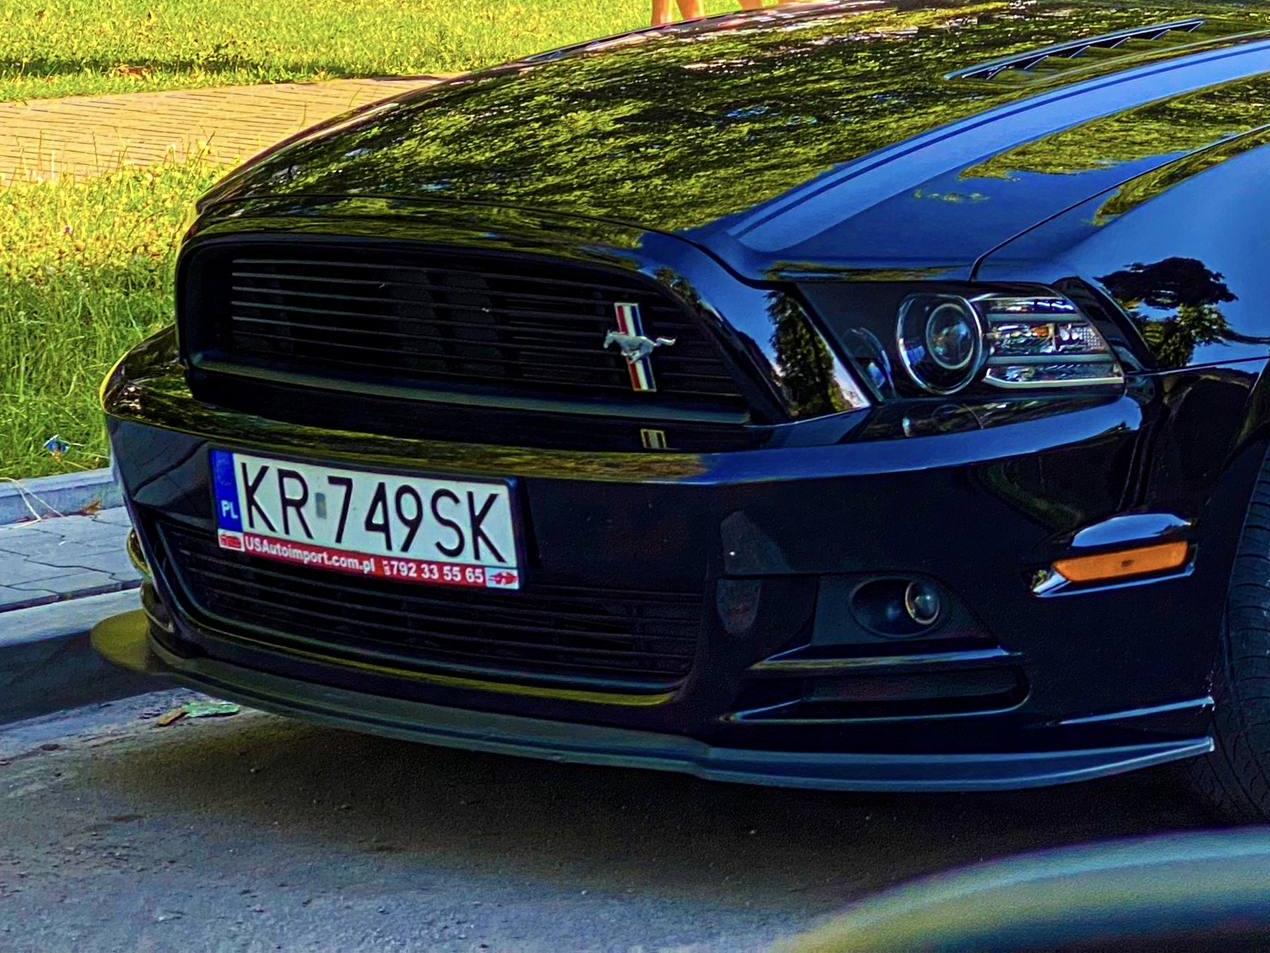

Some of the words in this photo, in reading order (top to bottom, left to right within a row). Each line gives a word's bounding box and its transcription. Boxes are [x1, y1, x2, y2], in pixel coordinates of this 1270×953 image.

[220, 500, 239, 520] PL
[241, 462, 314, 540] KR
[327, 475, 507, 564] 749SK
[244, 536, 376, 574] USAutoimport.com.pl
[390, 560, 417, 578] 792
[421, 563, 439, 580] 33
[443, 566, 462, 582] 55
[465, 568, 484, 584] 65
